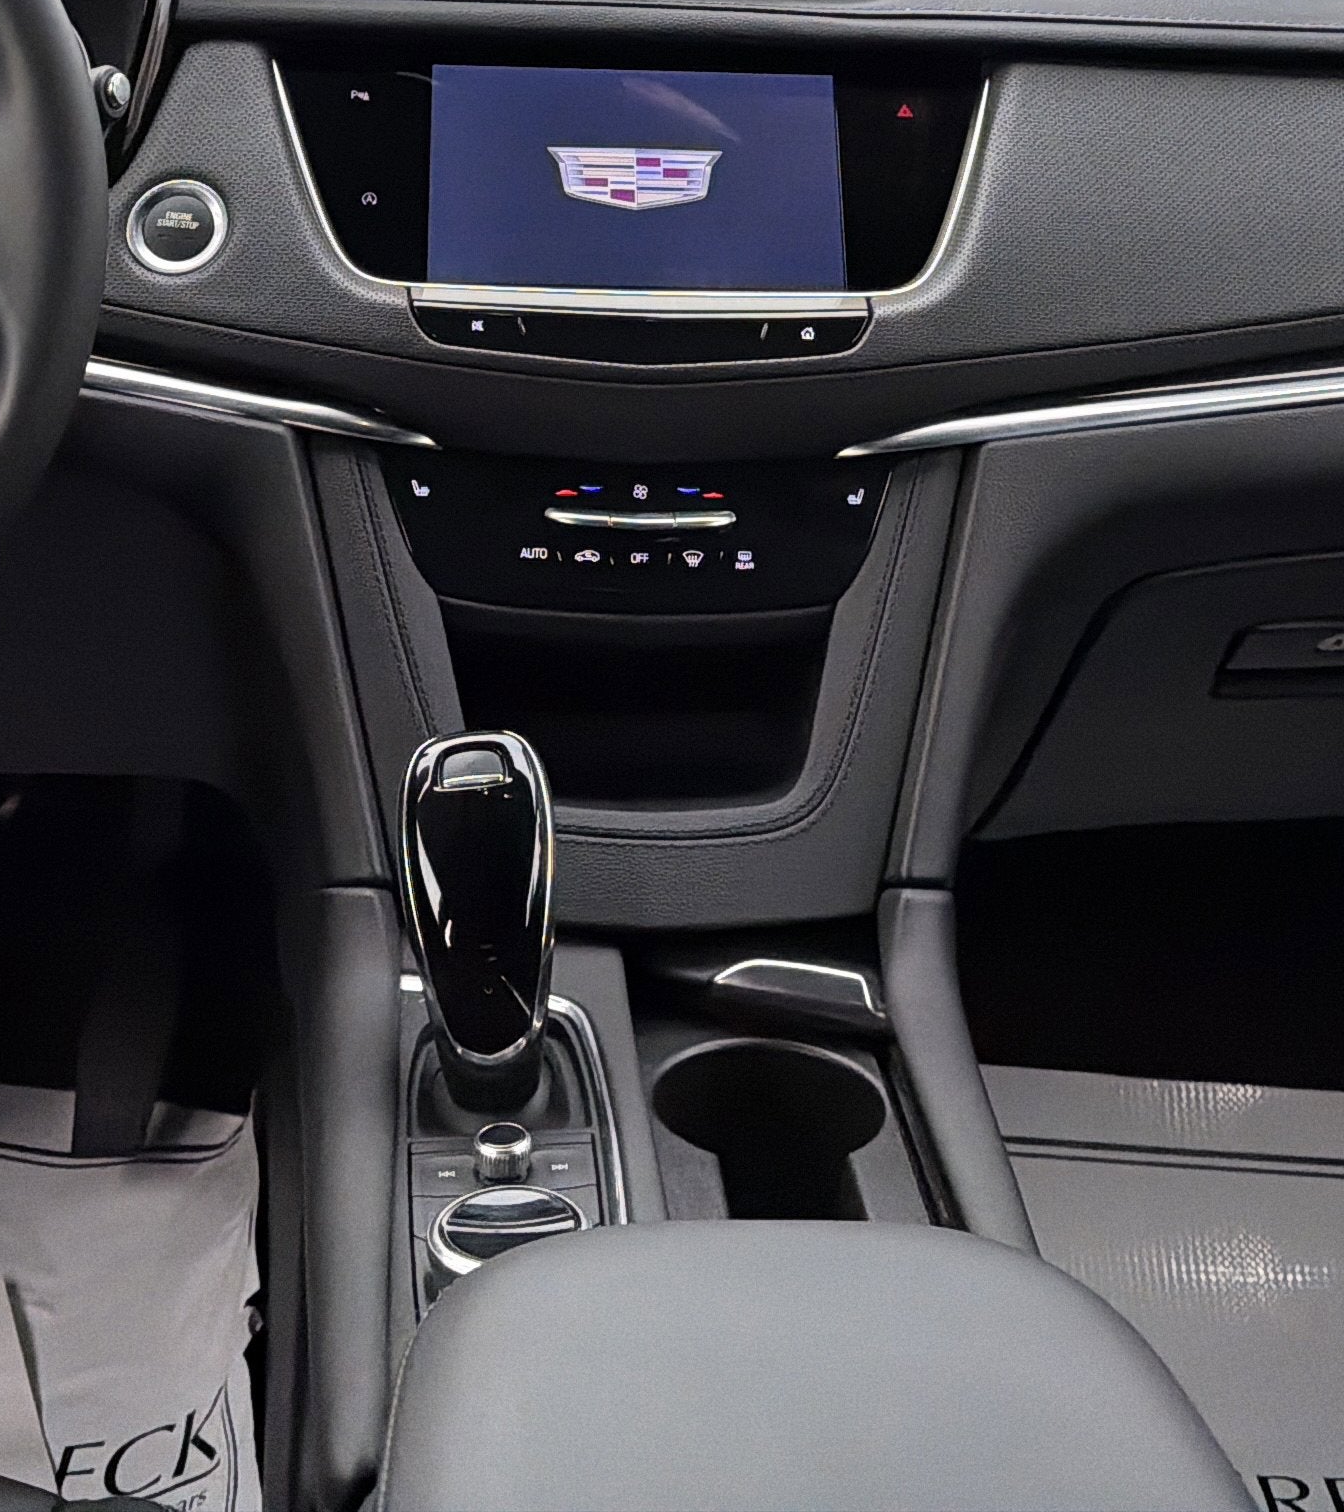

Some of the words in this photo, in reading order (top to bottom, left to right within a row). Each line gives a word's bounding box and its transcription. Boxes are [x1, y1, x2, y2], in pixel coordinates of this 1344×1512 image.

[165, 210, 194, 221] ENGINE
[157, 218, 200, 230] START/STOP
[519, 546, 549, 560] AUTO
[630, 552, 650, 564] OFF
[734, 561, 755, 570] REAR
